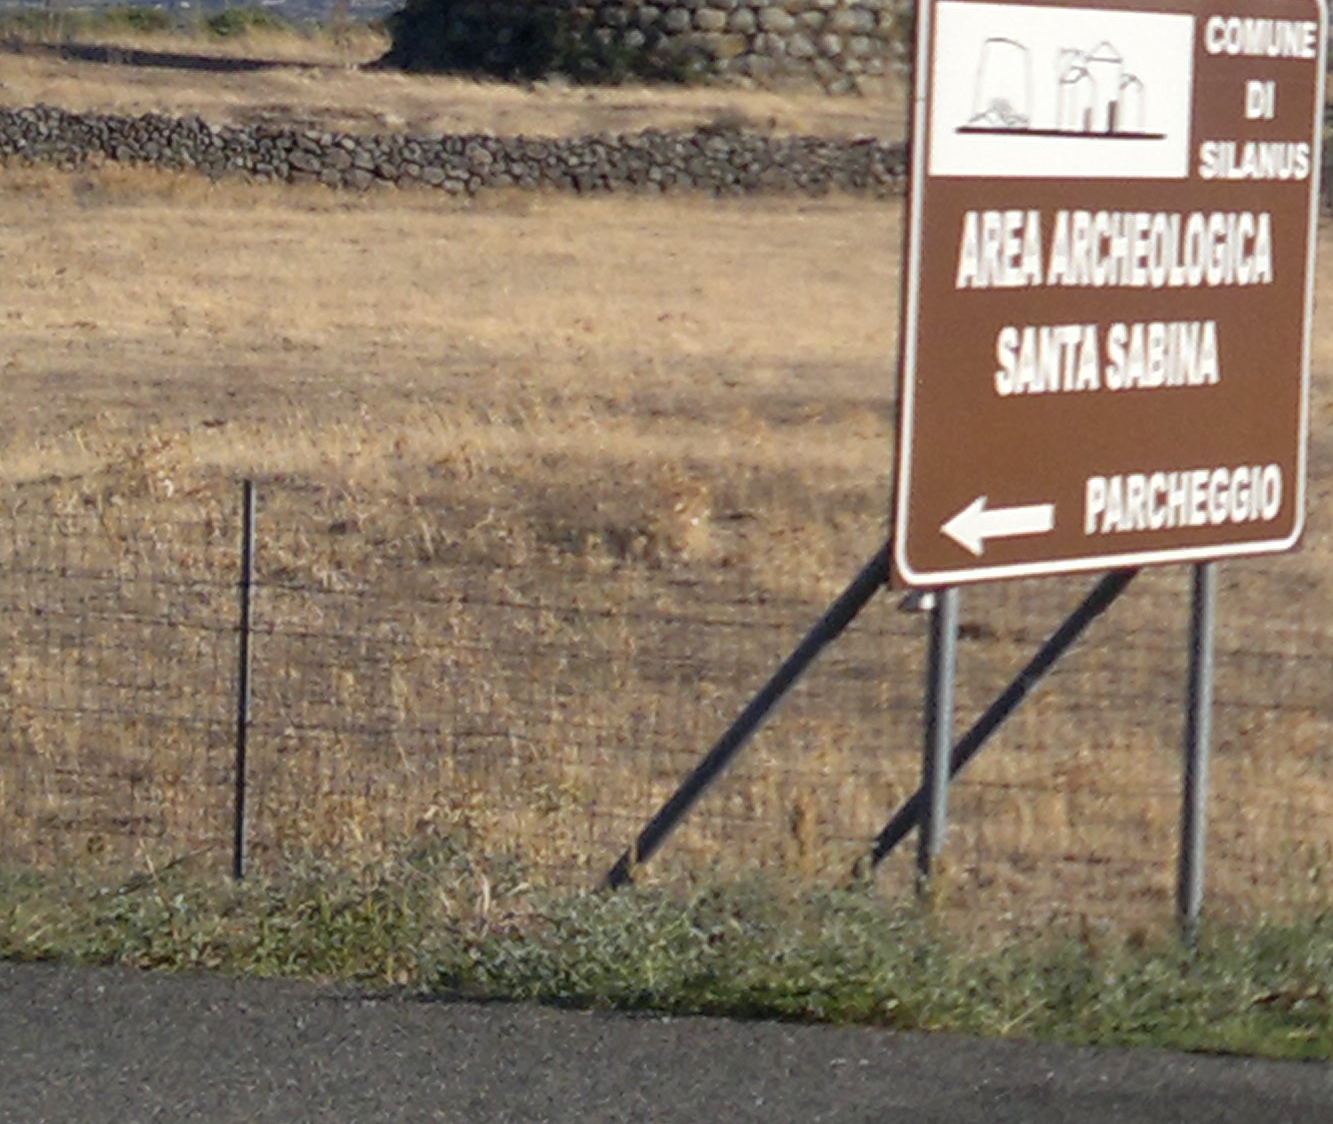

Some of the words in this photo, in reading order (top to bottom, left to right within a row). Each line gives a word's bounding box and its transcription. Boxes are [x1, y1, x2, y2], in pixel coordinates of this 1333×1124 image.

[1205, 15, 1317, 59] COMUNE
[1245, 81, 1274, 119] DI
[1199, 141, 1310, 181] SILANUS
[956, 211, 1041, 289] AREA
[1046, 210, 1273, 287] ARCHEOLOGICA
[994, 323, 1099, 396] SANTA
[1105, 321, 1220, 390] SABINA
[1085, 464, 1282, 535] PARCHEGGIO
